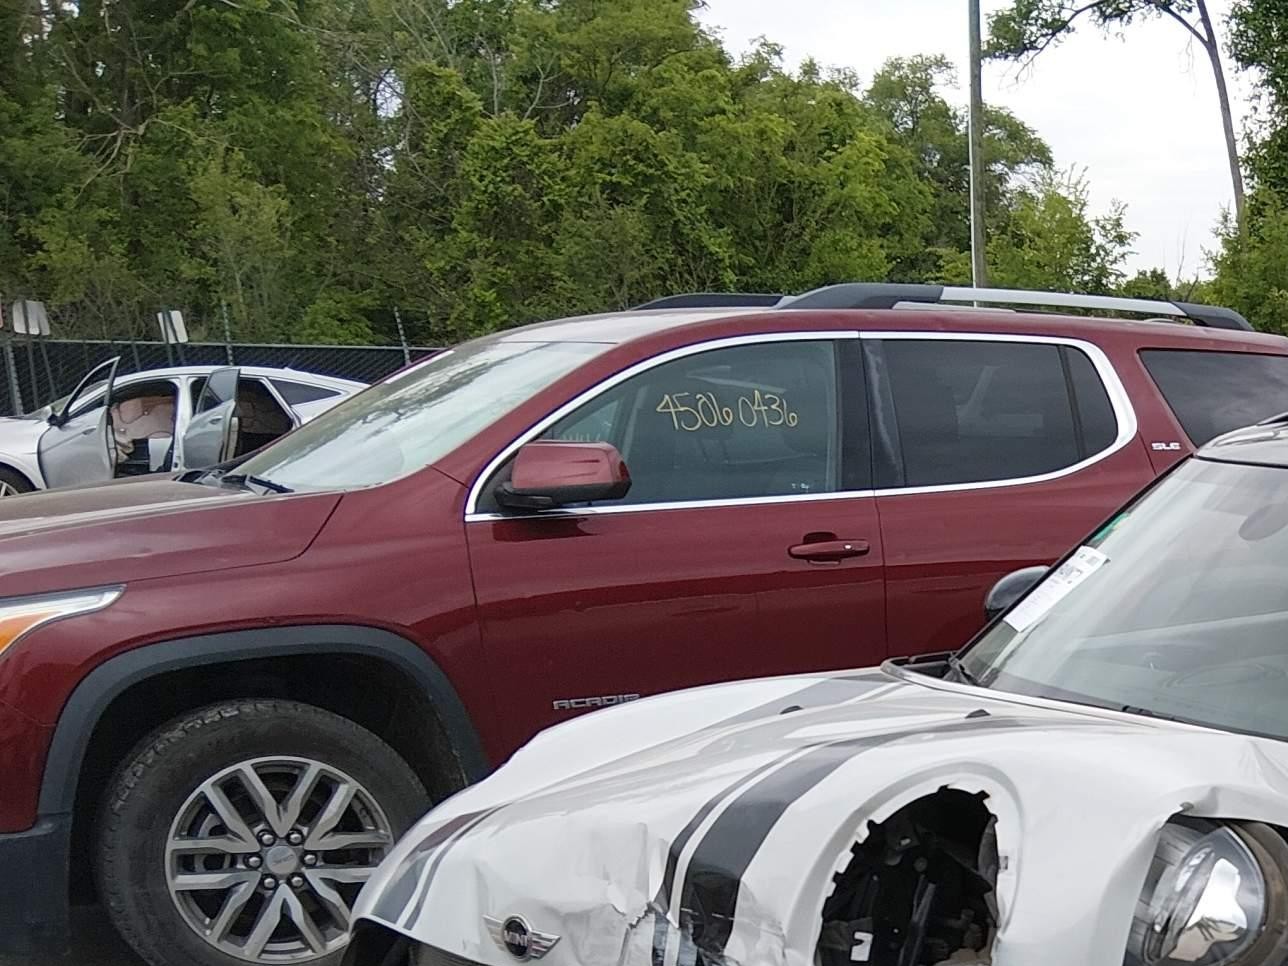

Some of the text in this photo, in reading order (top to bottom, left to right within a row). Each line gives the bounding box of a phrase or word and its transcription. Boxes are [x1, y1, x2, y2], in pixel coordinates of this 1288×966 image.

[1151, 442, 1181, 450] SLE
[552, 693, 641, 710] ACADIA
[502, 929, 531, 948] MINI
